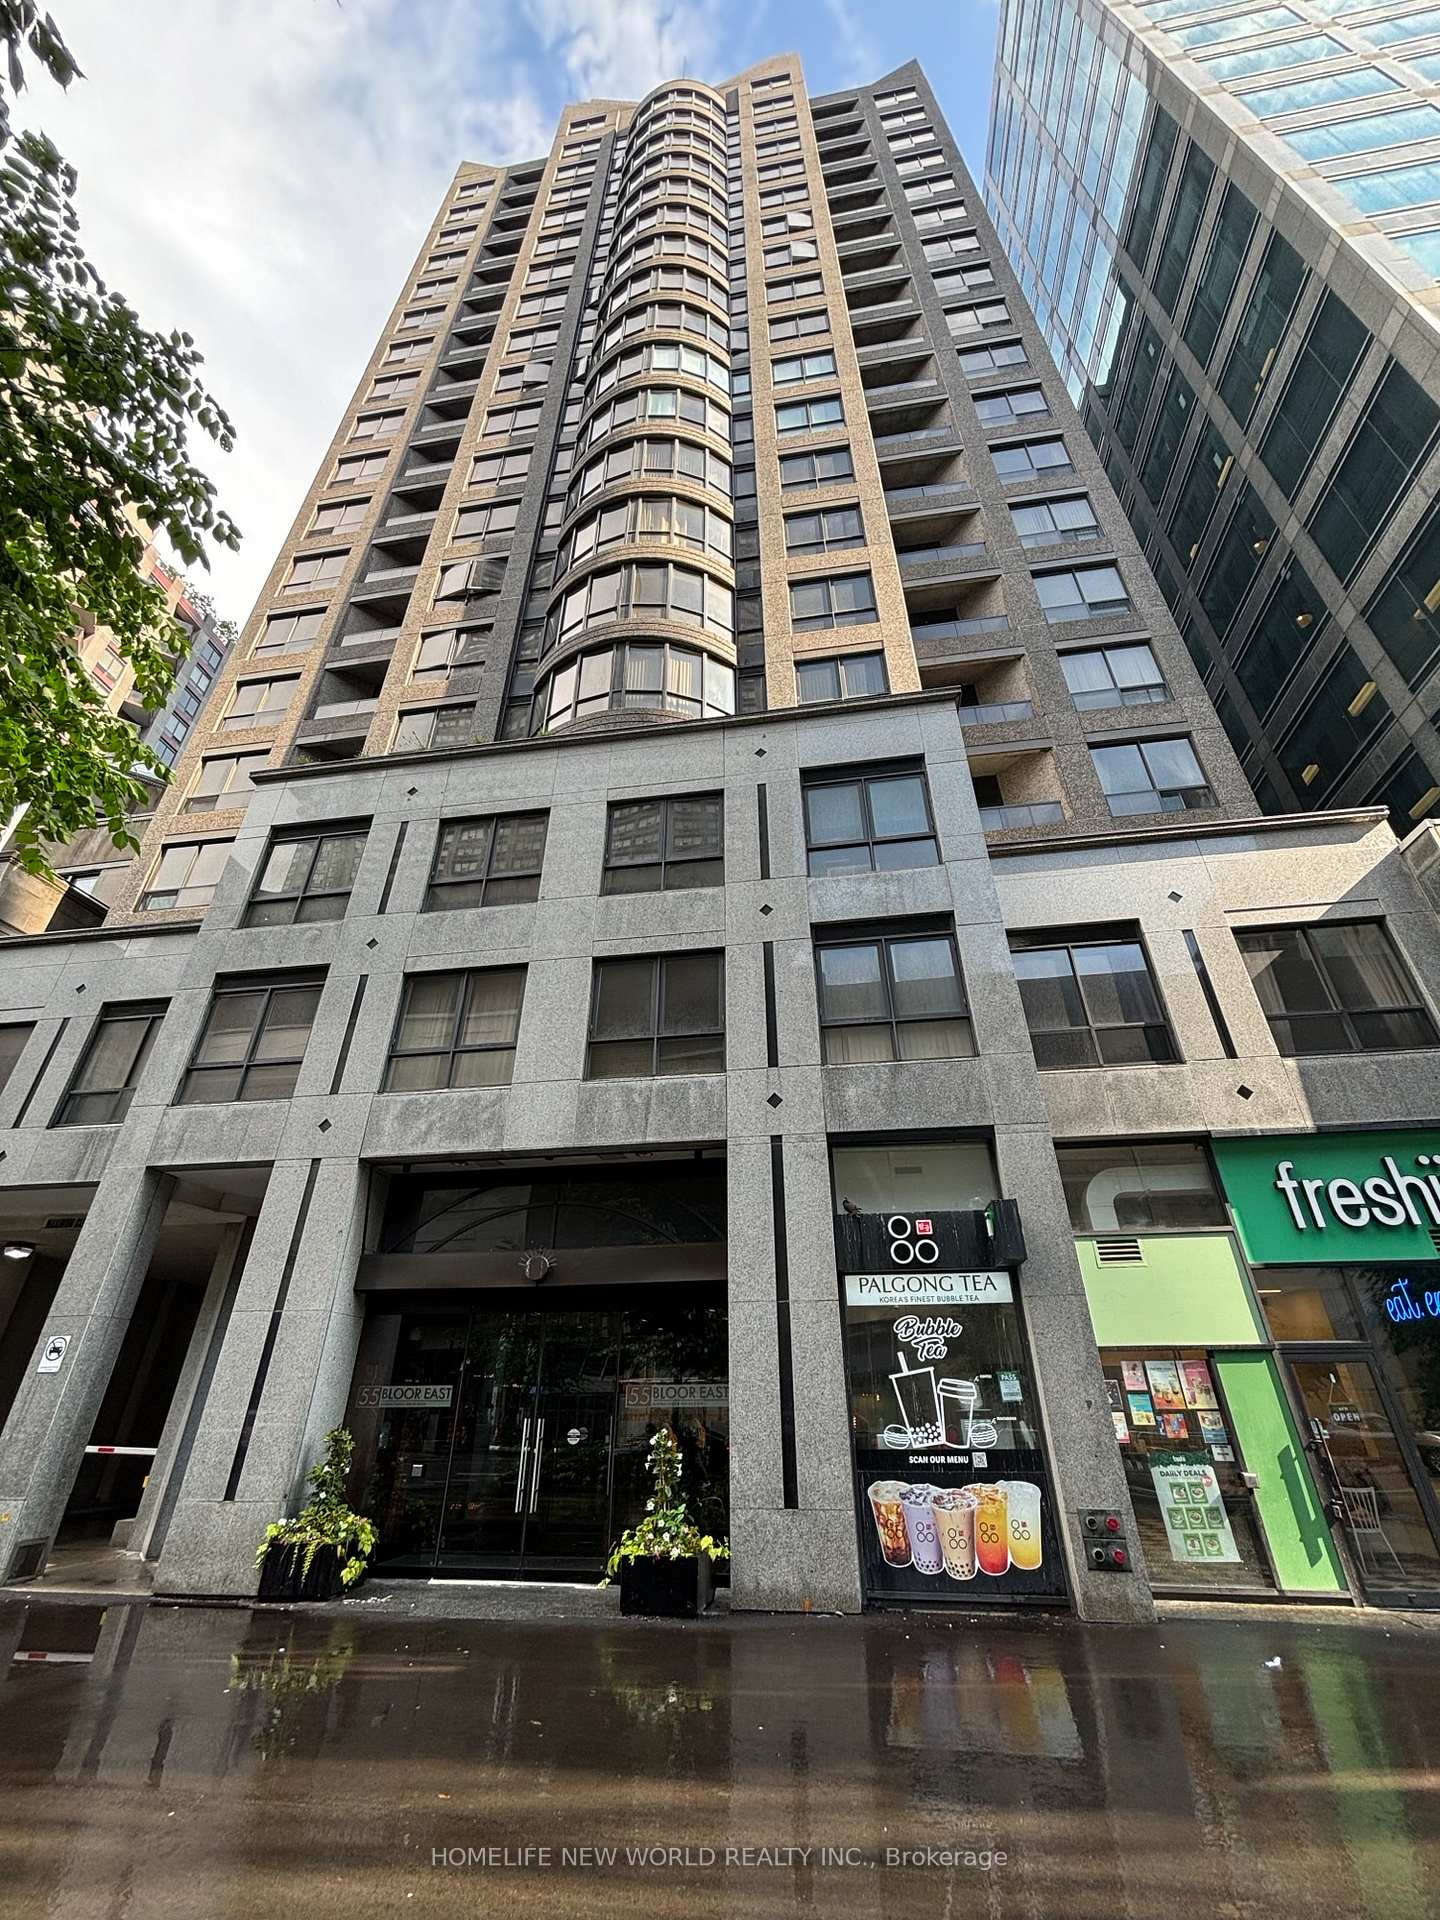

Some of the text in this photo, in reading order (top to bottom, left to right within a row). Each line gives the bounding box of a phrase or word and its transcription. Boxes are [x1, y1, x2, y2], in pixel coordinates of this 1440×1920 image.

[858, 1275, 997, 1293] PALGONG TEA
[879, 1294, 979, 1303] KOREA'S FINEST BUBBLE TEA
[893, 1315, 963, 1341] Bubble
[911, 1336, 947, 1361] Tea
[358, 1387, 452, 1405] 55 BLOOR EAST
[628, 1387, 650, 1405] 55
[653, 1386, 696, 1399] BLOOR
[1333, 1412, 1360, 1421] OPEN
[909, 1456, 968, 1464] SCAN OUR MENU
